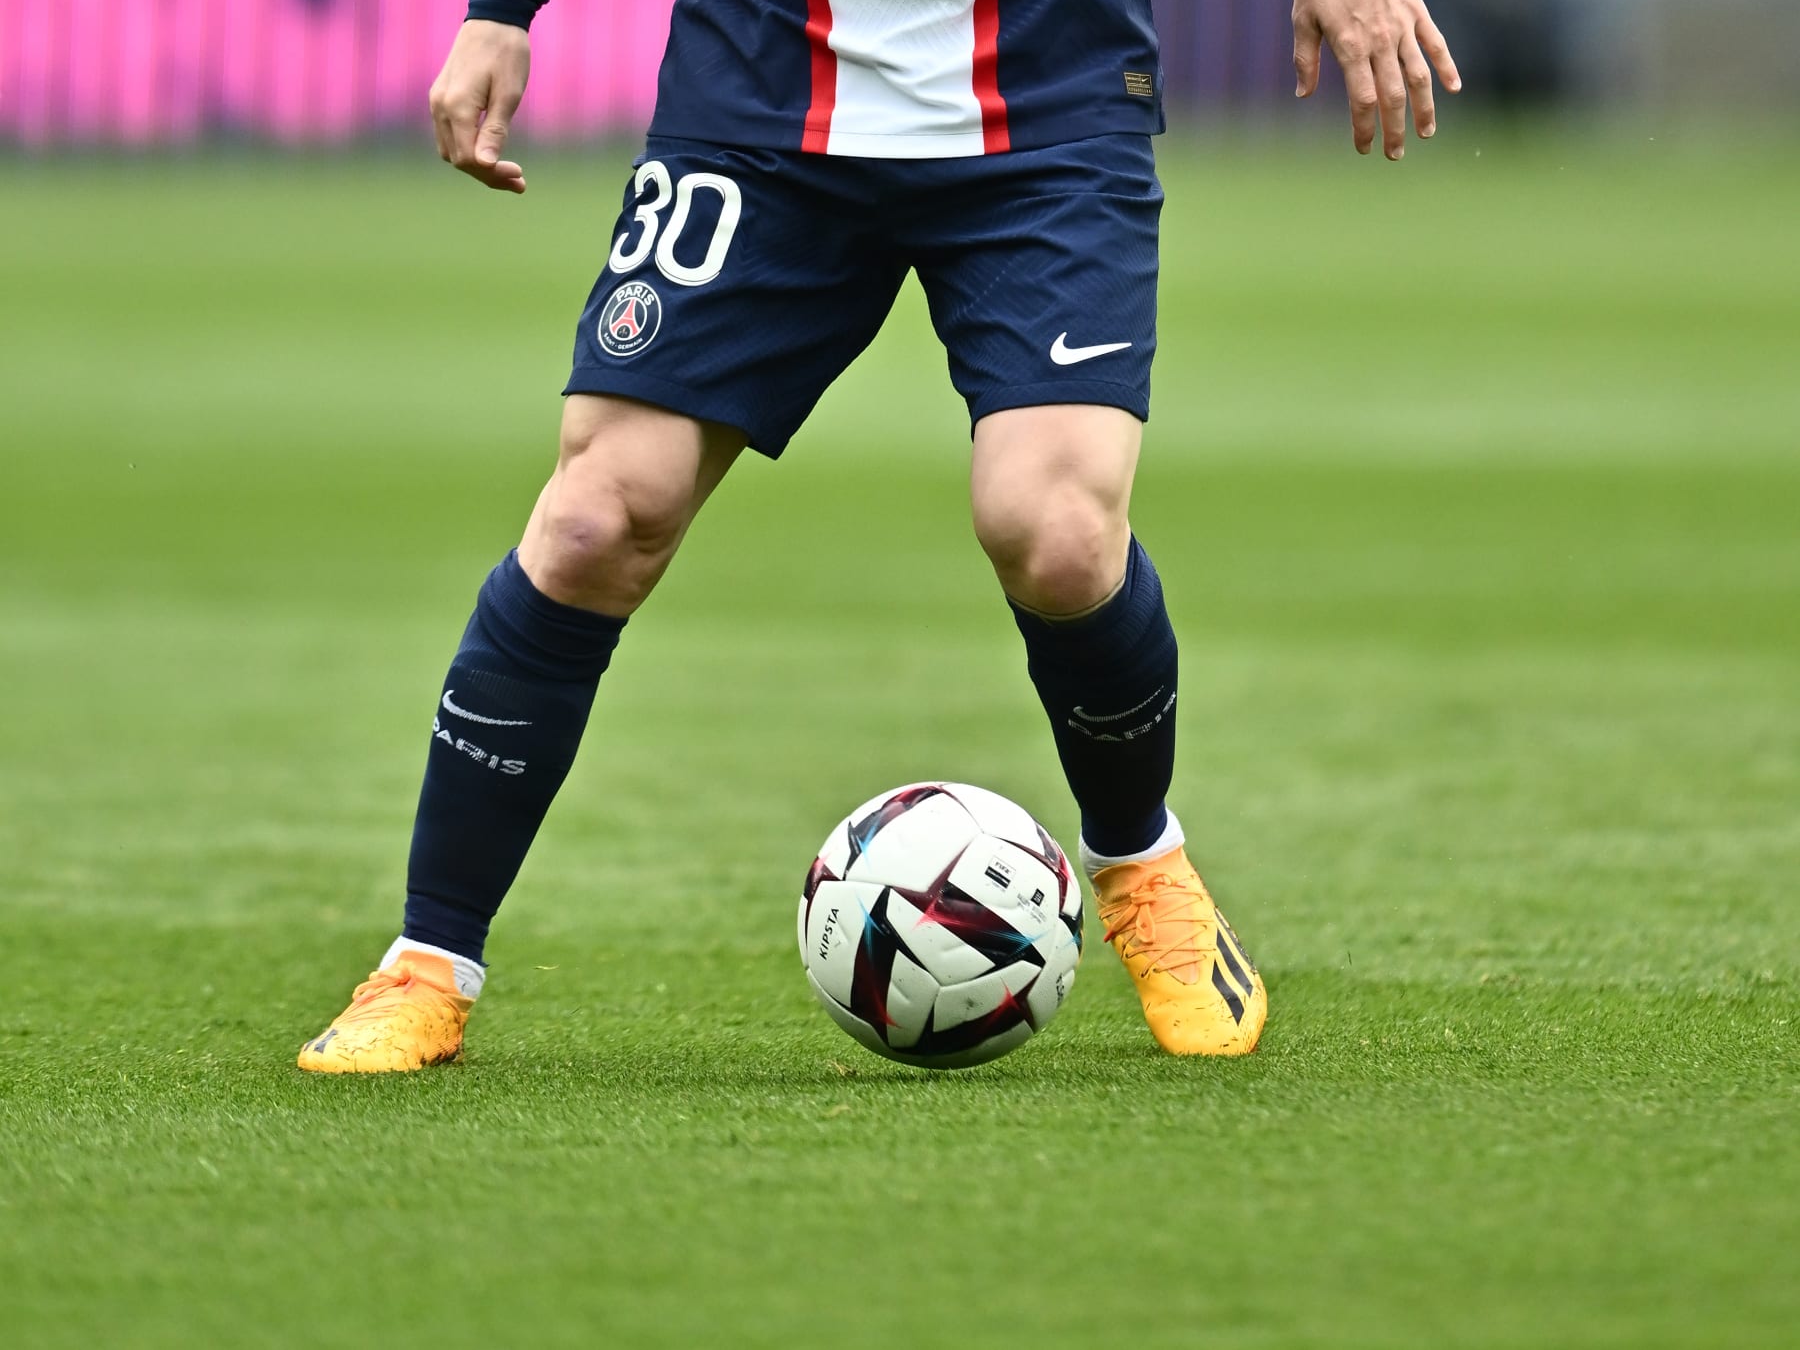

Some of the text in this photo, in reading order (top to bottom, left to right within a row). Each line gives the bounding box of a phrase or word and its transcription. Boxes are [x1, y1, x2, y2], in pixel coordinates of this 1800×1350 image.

[608, 160, 742, 286] 30
[616, 285, 655, 306] PARIS
[819, 908, 839, 960] KIPSTA
